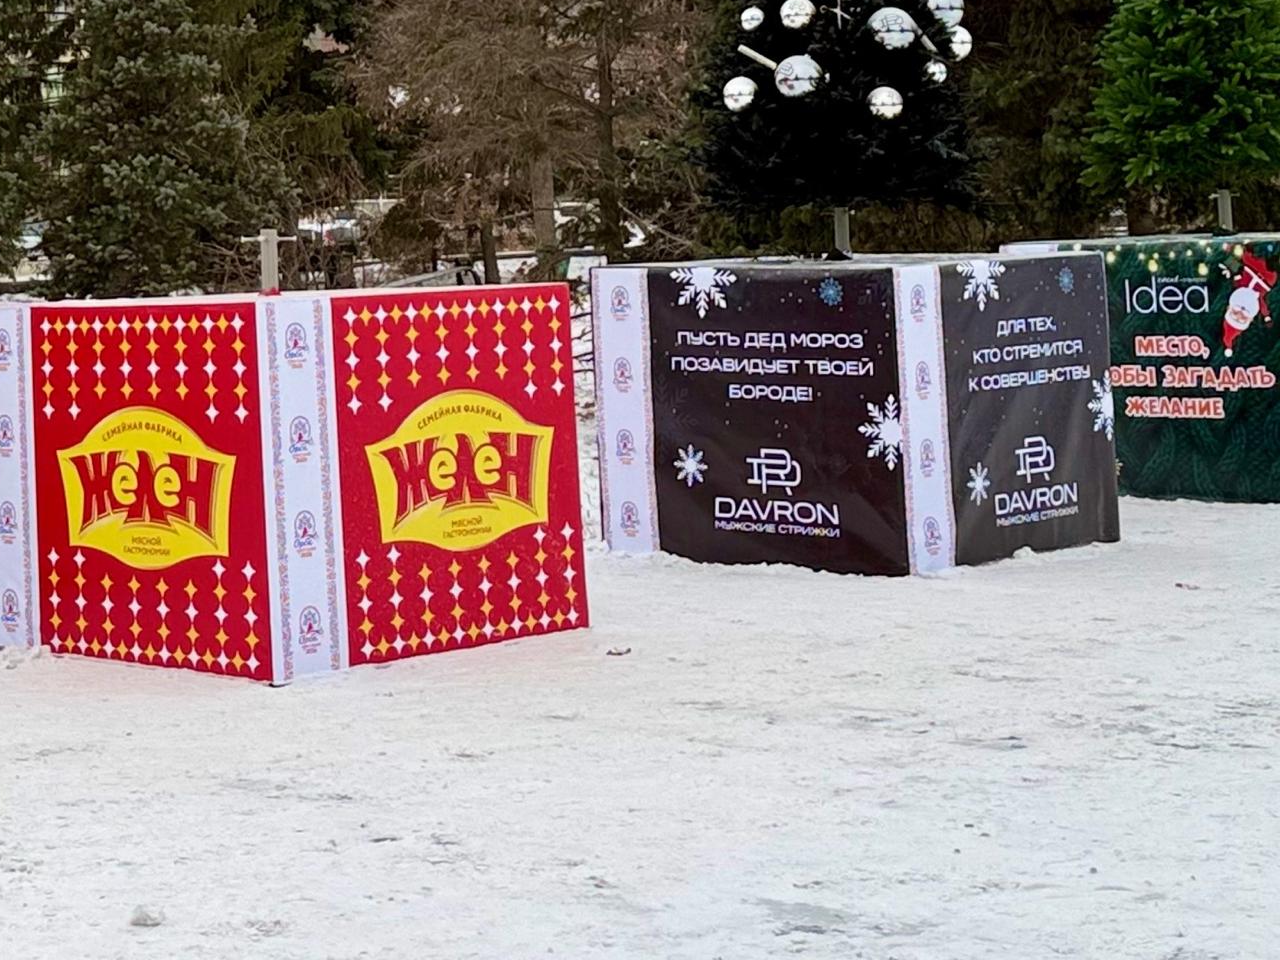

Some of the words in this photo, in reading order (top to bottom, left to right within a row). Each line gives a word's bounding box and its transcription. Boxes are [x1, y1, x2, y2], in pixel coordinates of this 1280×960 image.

[1125, 275, 1209, 314] Idea
[997, 319, 1026, 337] ДЛЯ
[1027, 316, 1056, 332] ТЕХ,
[677, 331, 740, 347] ПУСТЬ
[744, 332, 787, 349] ДЕД
[791, 333, 864, 349] МОРОЗ
[972, 348, 1000, 364] КТО
[1003, 339, 1083, 361] СТРЕМИТСЯ
[1135, 336, 1210, 359] МЕСТО,
[671, 357, 800, 375] ПОЗАВИДУЕТ
[804, 357, 874, 376] ТВОЕЙ
[968, 377, 979, 392] К
[980, 364, 1091, 390] СОВЕРШЕНСТВУ
[1162, 365, 1276, 391] ЗАГАДАТЬ
[729, 384, 813, 402] БОРОДЕ!
[417, 404, 462, 431] СЕМЕЙНАЯ
[463, 404, 502, 422] ФАБРИКА
[1125, 396, 1225, 418] ЖЕЛАНИЕ
[102, 421, 143, 442] СЕМЕЙНАЯ
[144, 421, 183, 444] ФАБРИКА
[994, 482, 1078, 515] DAVRON
[714, 497, 839, 525] DAVRON
[778, 524, 840, 538] СТРИЖКИ
